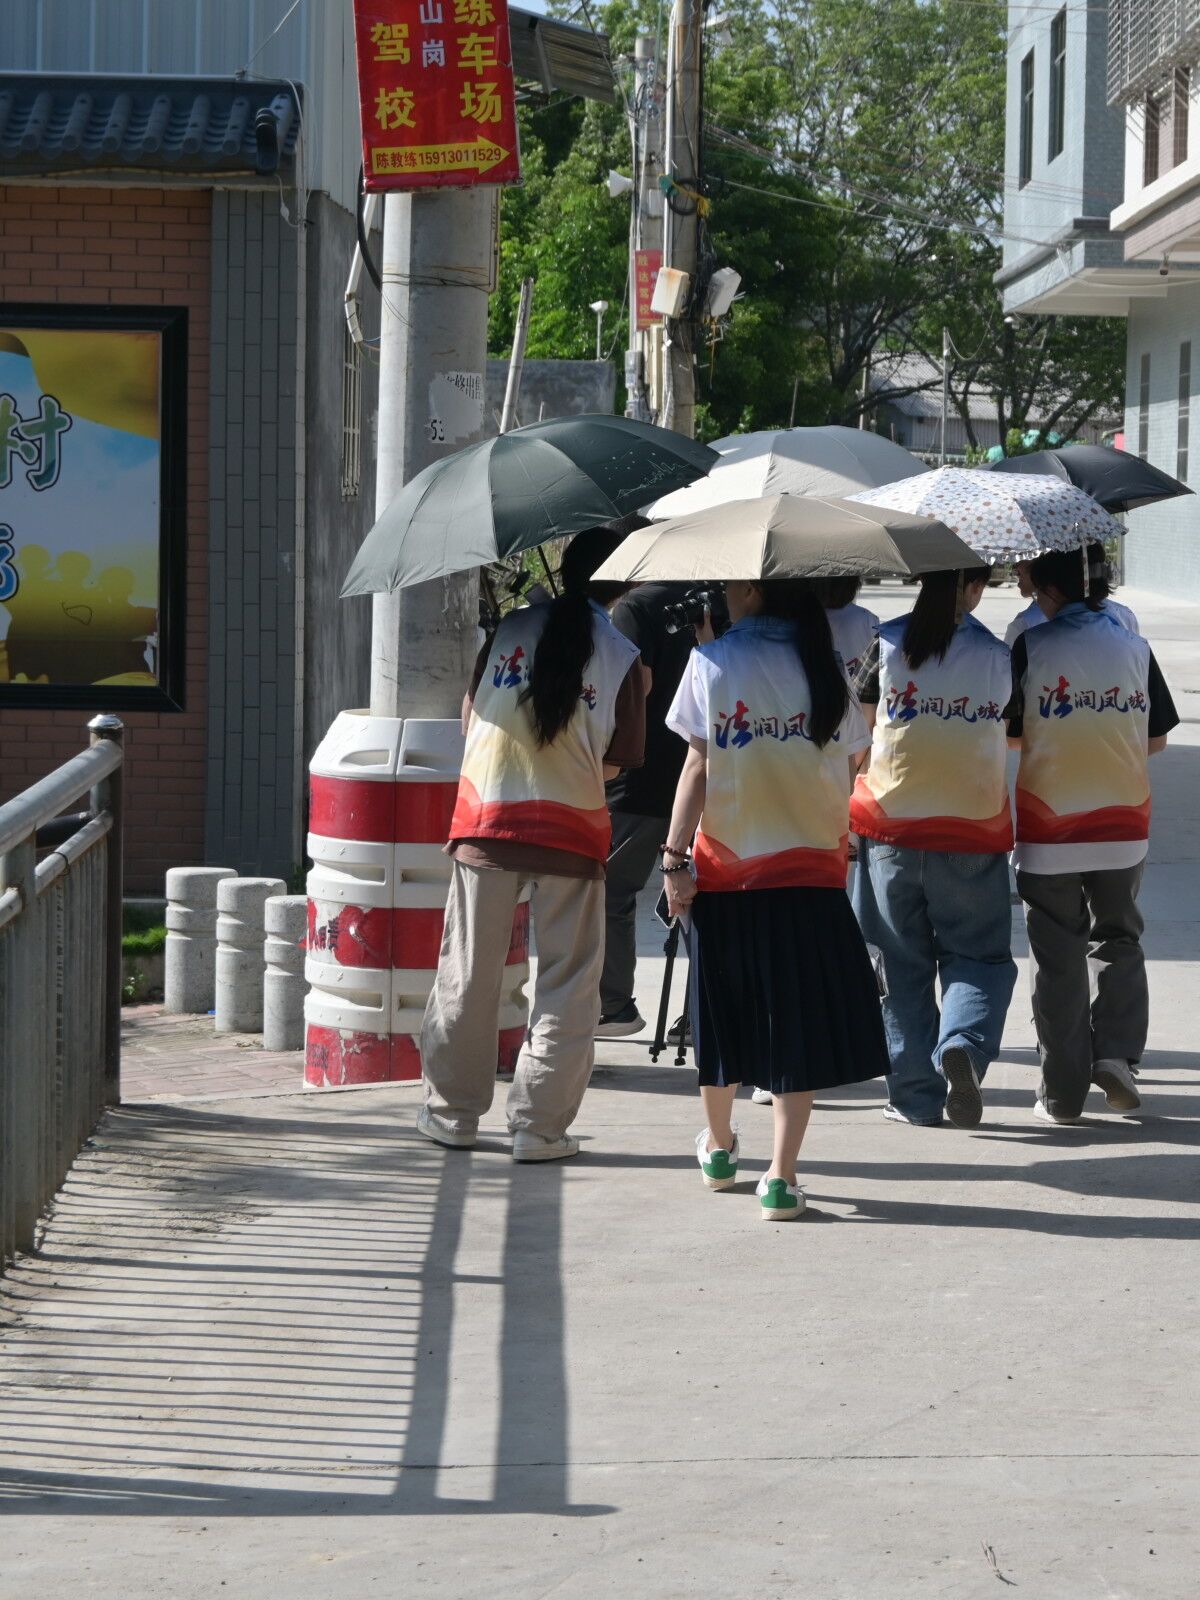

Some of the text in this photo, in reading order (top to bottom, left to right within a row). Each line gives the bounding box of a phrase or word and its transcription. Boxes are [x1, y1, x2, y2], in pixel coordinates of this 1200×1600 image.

[419, 0, 446, 68] 山岗
[453, 0, 502, 124] 练车场
[370, 22, 417, 130] 驾校
[713, 699, 841, 749] 法润凤
[885, 680, 1006, 723] 法润凤城
[1038, 675, 1147, 719] 法润凤城
